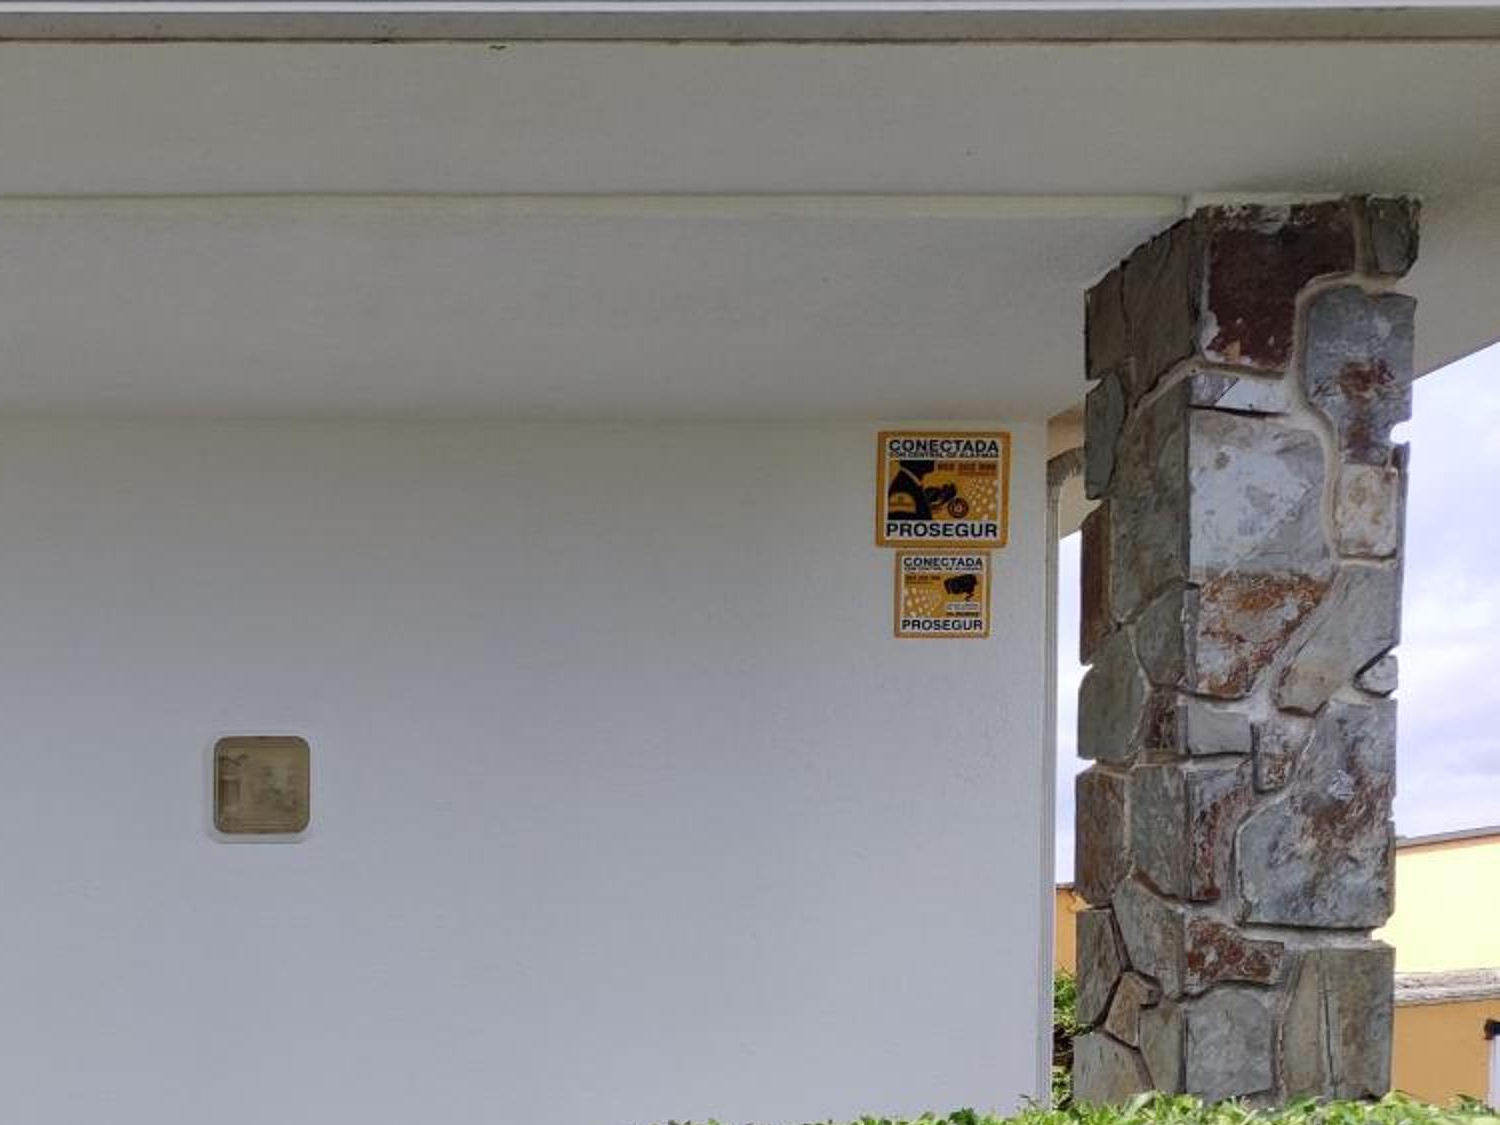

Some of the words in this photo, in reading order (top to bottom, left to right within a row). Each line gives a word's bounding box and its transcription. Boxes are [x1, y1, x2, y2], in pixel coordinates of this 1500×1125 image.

[889, 439, 999, 453] CONECTADA
[886, 523, 997, 537] PROSEGUR
[903, 557, 982, 567] CONECTADA
[901, 619, 982, 630] PROSEGUR
